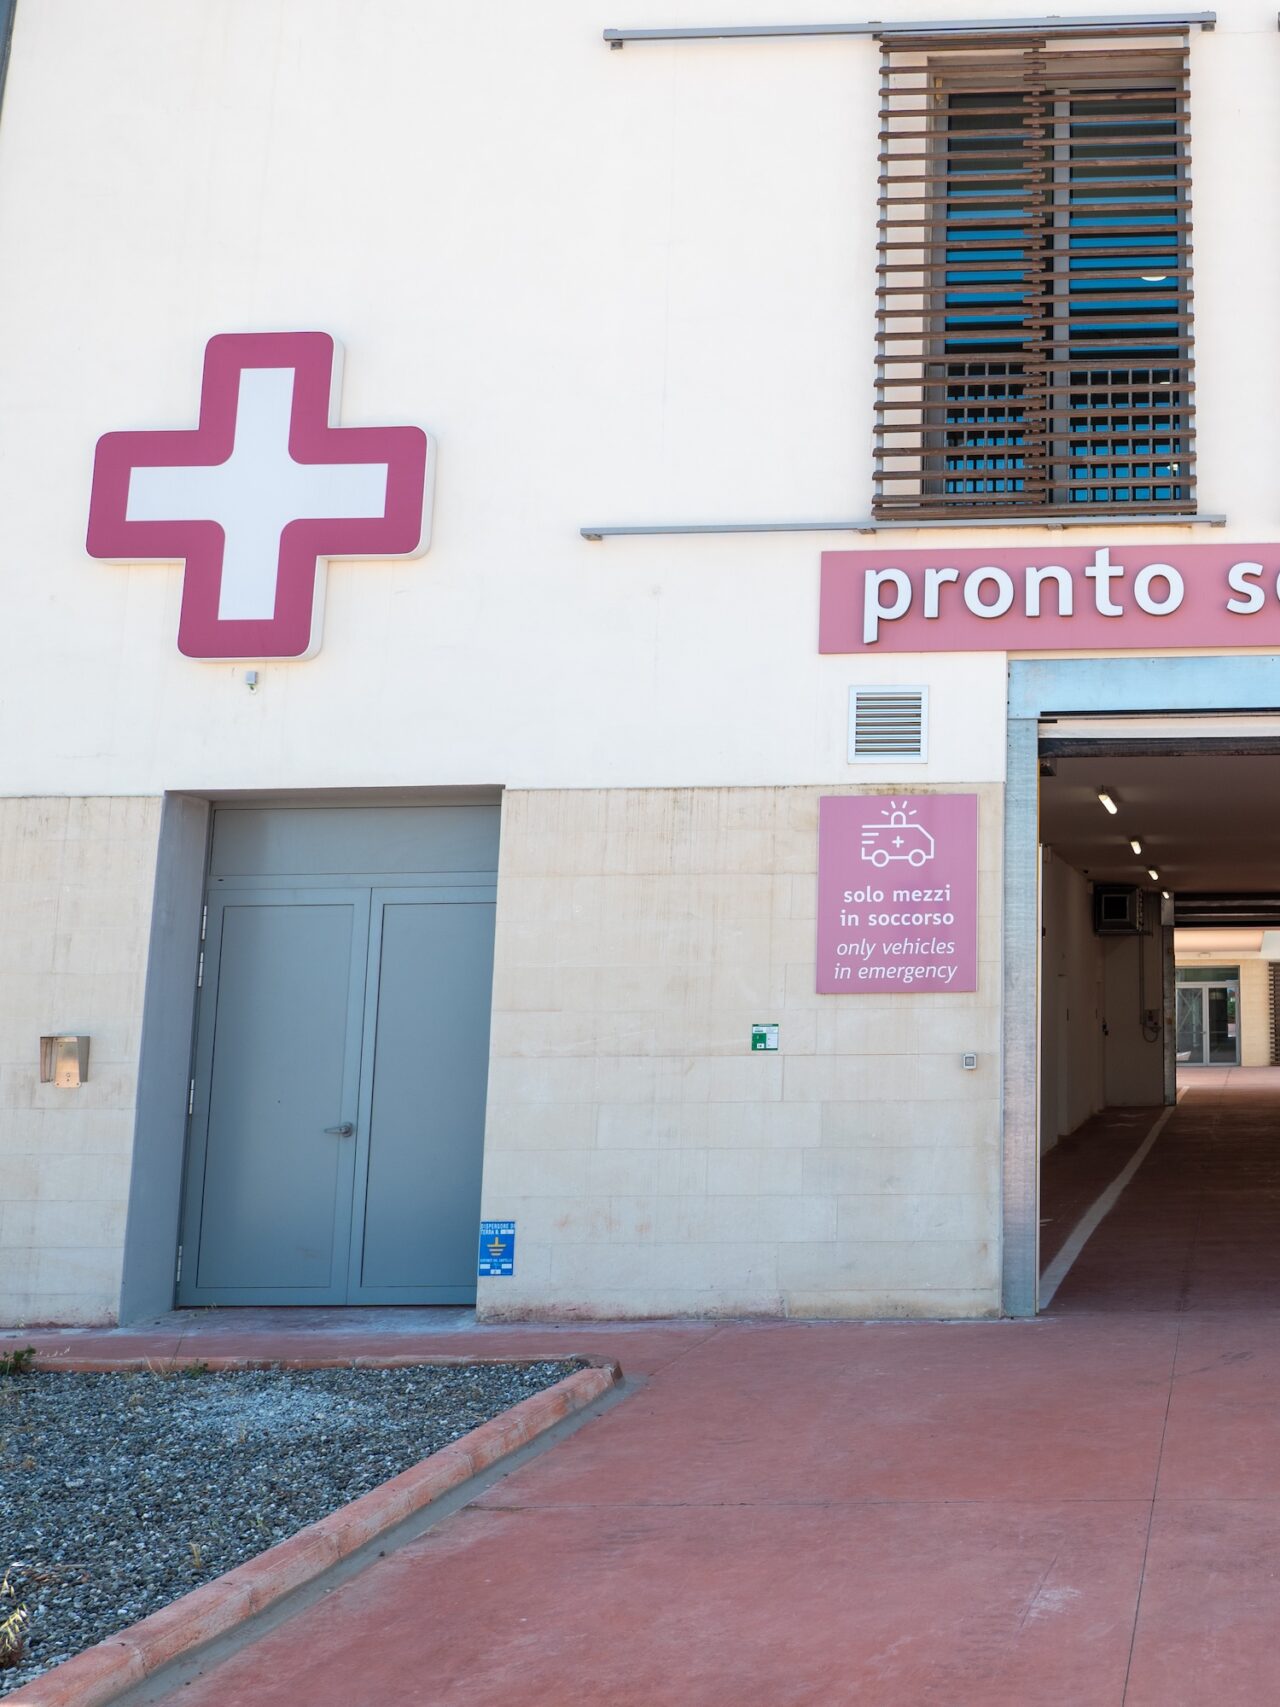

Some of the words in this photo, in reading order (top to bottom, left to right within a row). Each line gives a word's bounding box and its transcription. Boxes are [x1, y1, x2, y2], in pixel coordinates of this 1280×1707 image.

[863, 547, 1186, 643] pronto
[843, 885, 885, 903] solo
[893, 884, 951, 902] mezzi
[840, 910, 859, 926] in
[868, 912, 955, 926] soccorso
[836, 938, 877, 961] only
[882, 937, 955, 955] vehicles
[834, 962, 852, 980] in
[858, 965, 958, 984] emergency
